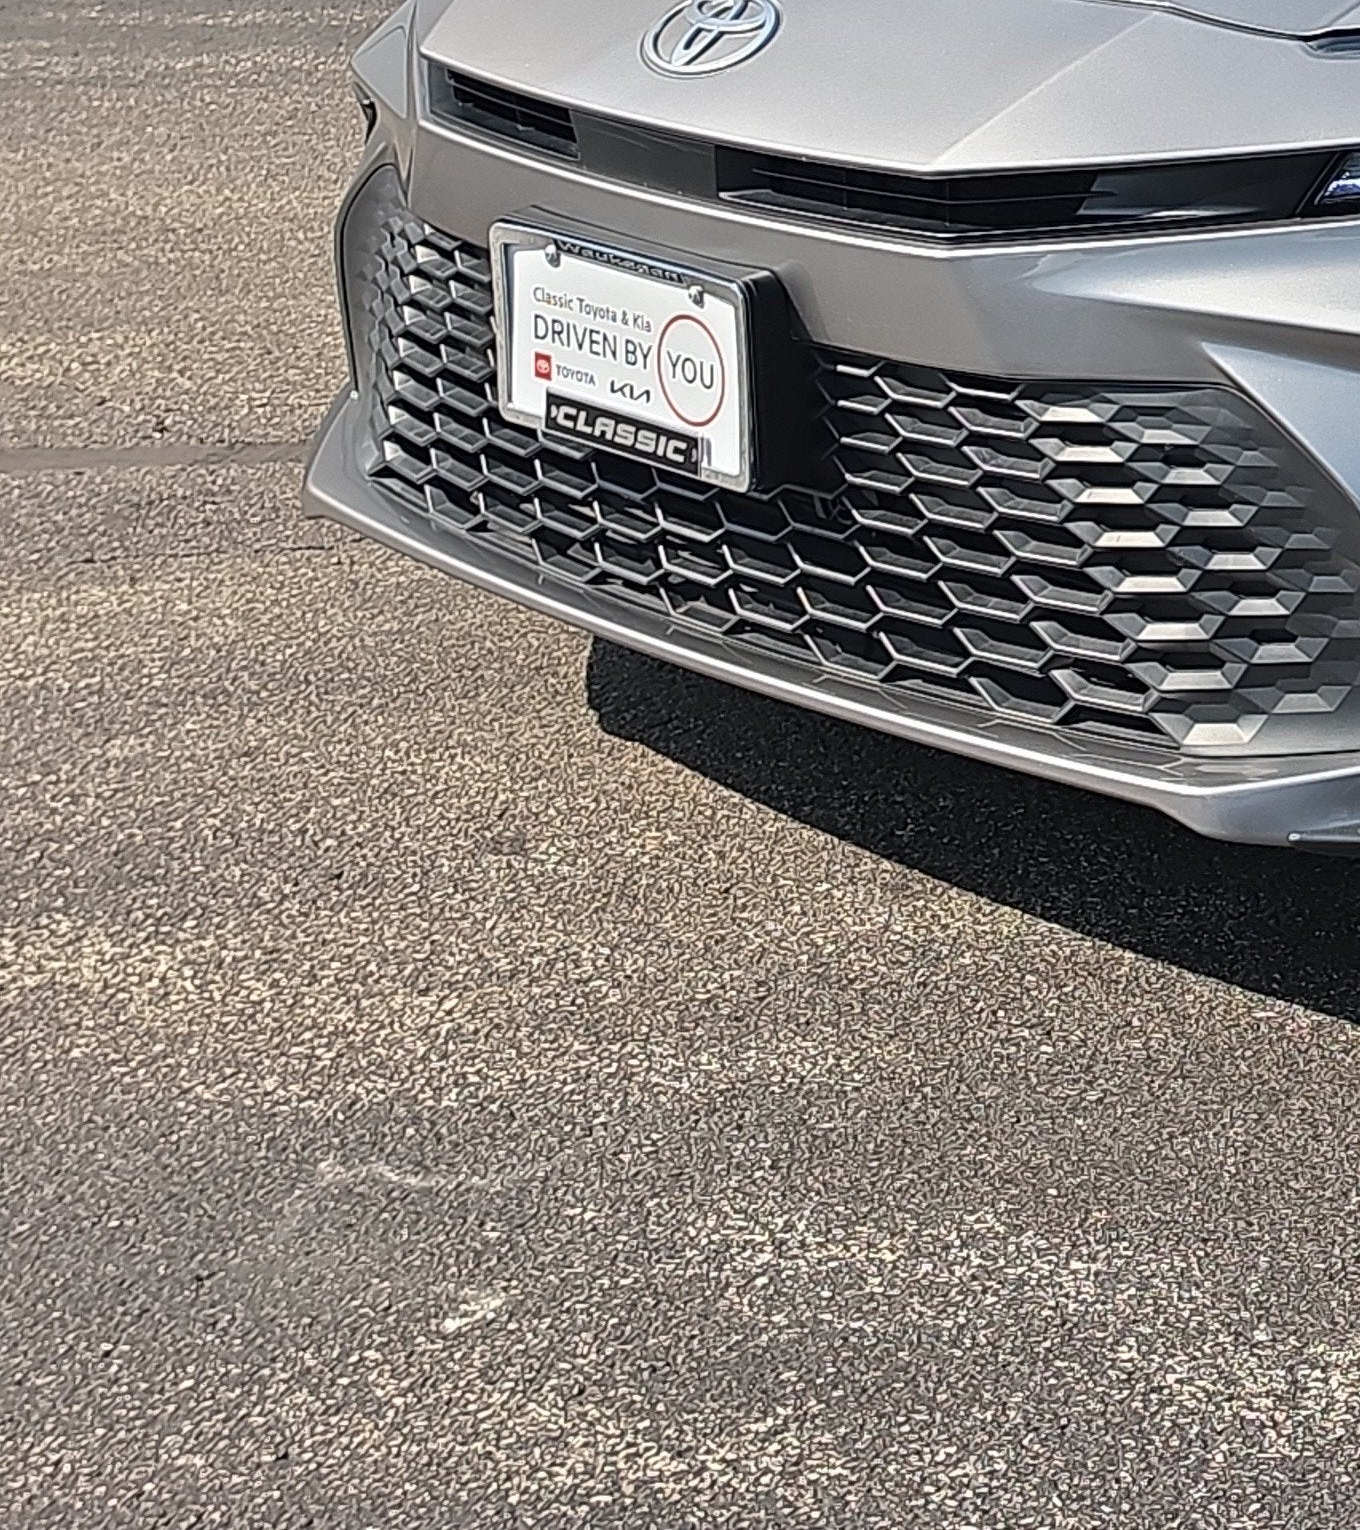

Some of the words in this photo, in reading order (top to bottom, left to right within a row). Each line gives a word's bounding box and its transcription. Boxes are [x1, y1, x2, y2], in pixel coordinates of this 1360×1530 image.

[559, 238, 680, 282] Waukegan
[533, 286, 574, 310] Classic
[576, 297, 617, 322] Toyota
[621, 310, 629, 326] &
[633, 313, 652, 332] Kia
[534, 313, 617, 361] DRIVEN
[624, 338, 653, 370] BY
[666, 349, 714, 390] YOU
[556, 364, 596, 387] TOYOTA
[556, 405, 688, 463] CLASSIC
